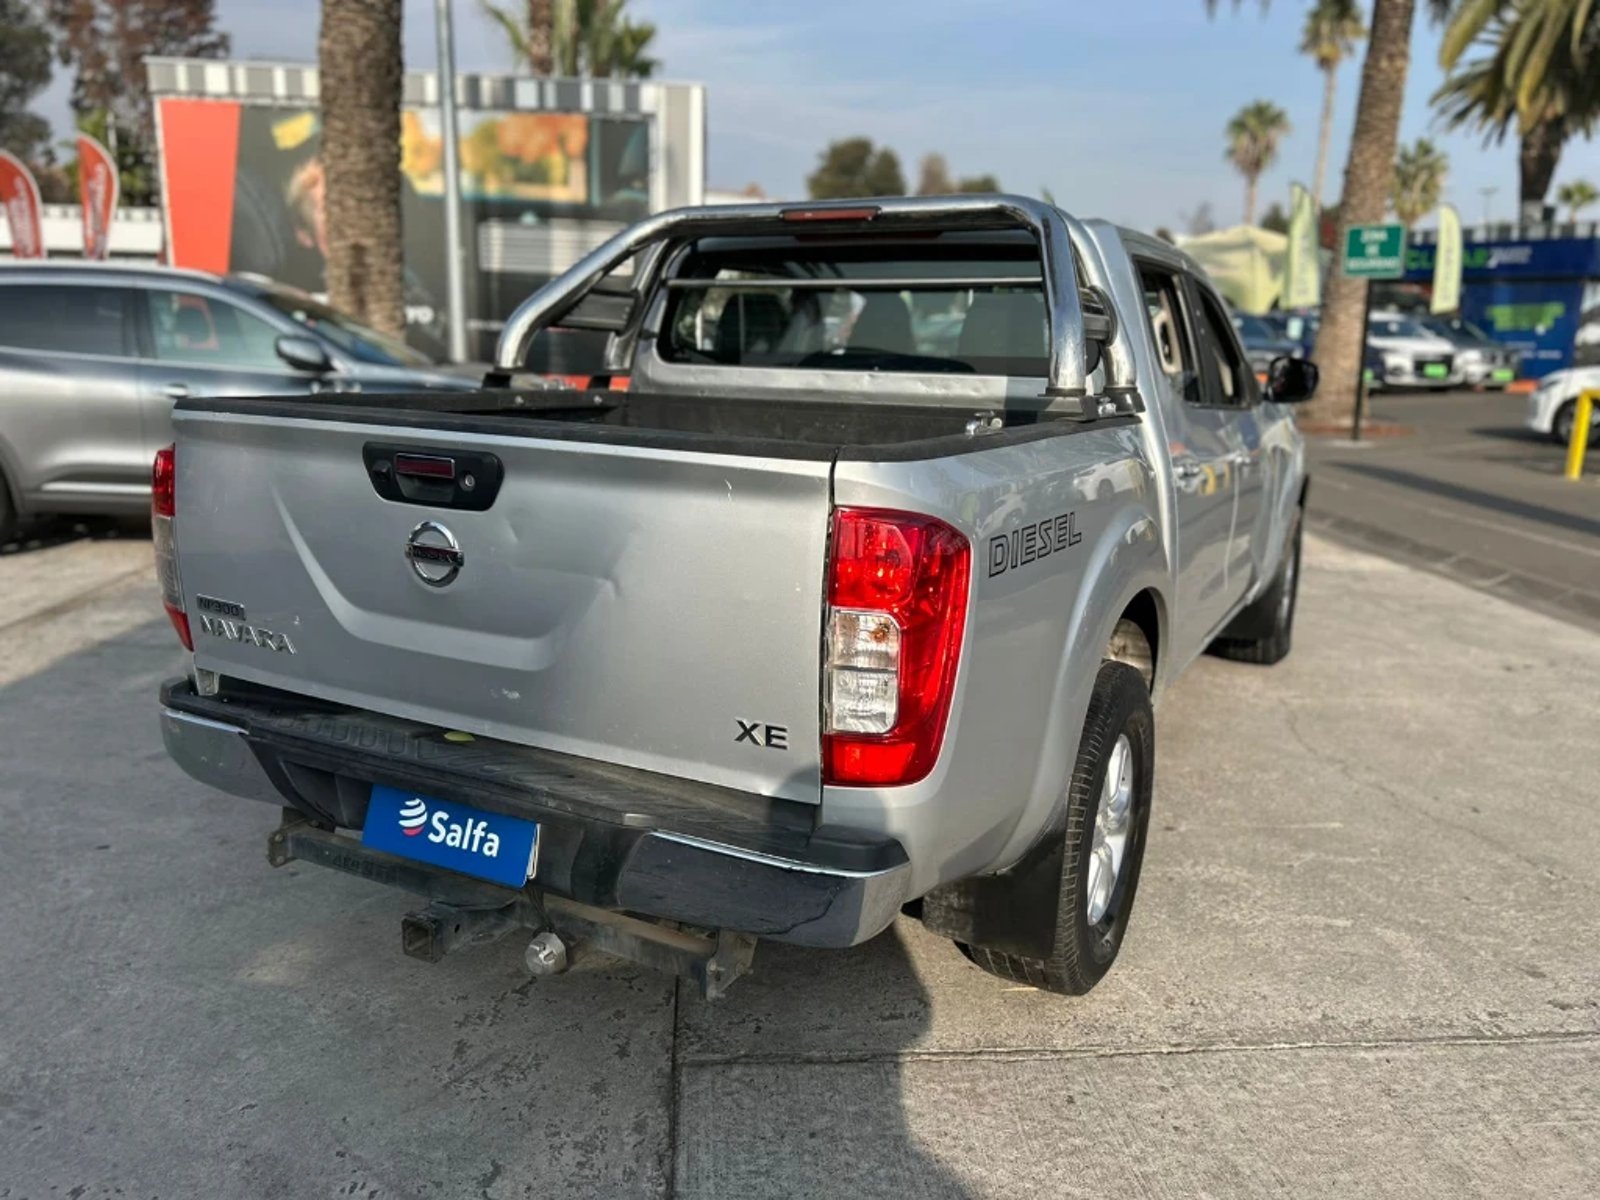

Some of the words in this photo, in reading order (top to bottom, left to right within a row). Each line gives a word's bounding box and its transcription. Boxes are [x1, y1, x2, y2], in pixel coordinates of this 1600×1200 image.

[988, 511, 1082, 578] DIESEL
[198, 595, 244, 618] NP300
[200, 614, 297, 655] NAVARA
[734, 717, 789, 751] XE
[427, 810, 501, 858] Salfa
